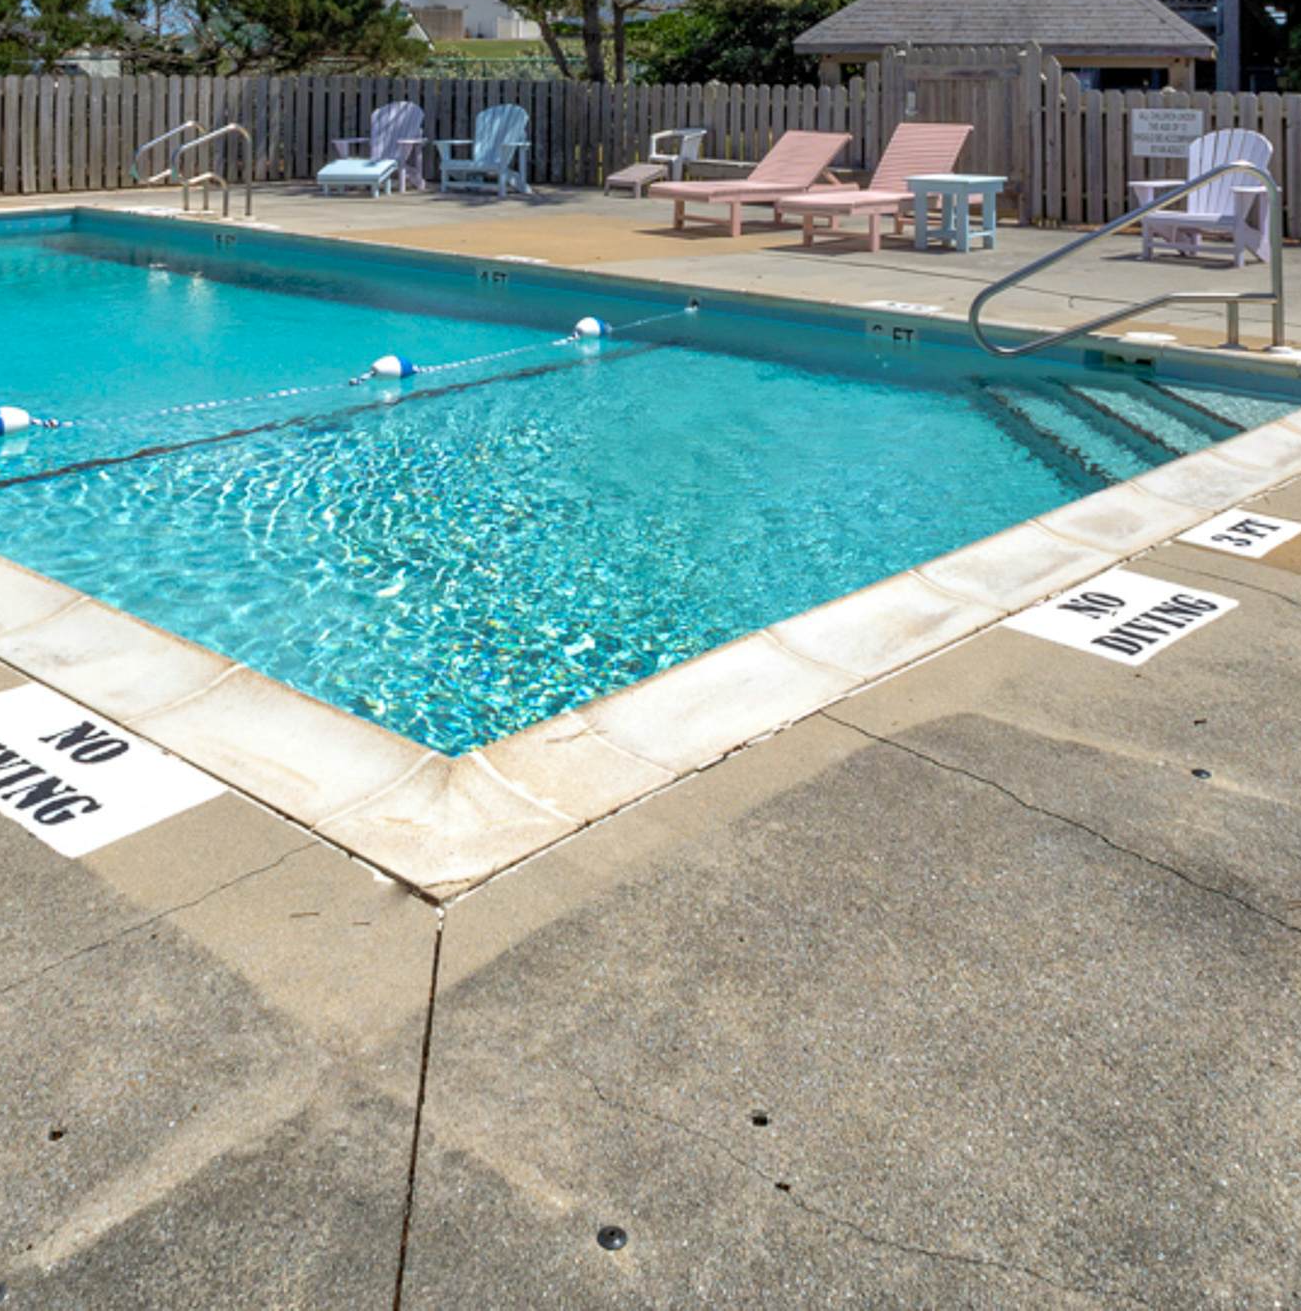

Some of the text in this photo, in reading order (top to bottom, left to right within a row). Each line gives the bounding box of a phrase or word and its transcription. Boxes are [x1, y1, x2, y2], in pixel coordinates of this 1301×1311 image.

[1211, 518, 1282, 546] 3 FT
[1057, 592, 1126, 619] NO
[1091, 593, 1219, 656] DIVING
[38, 720, 130, 765] NO
